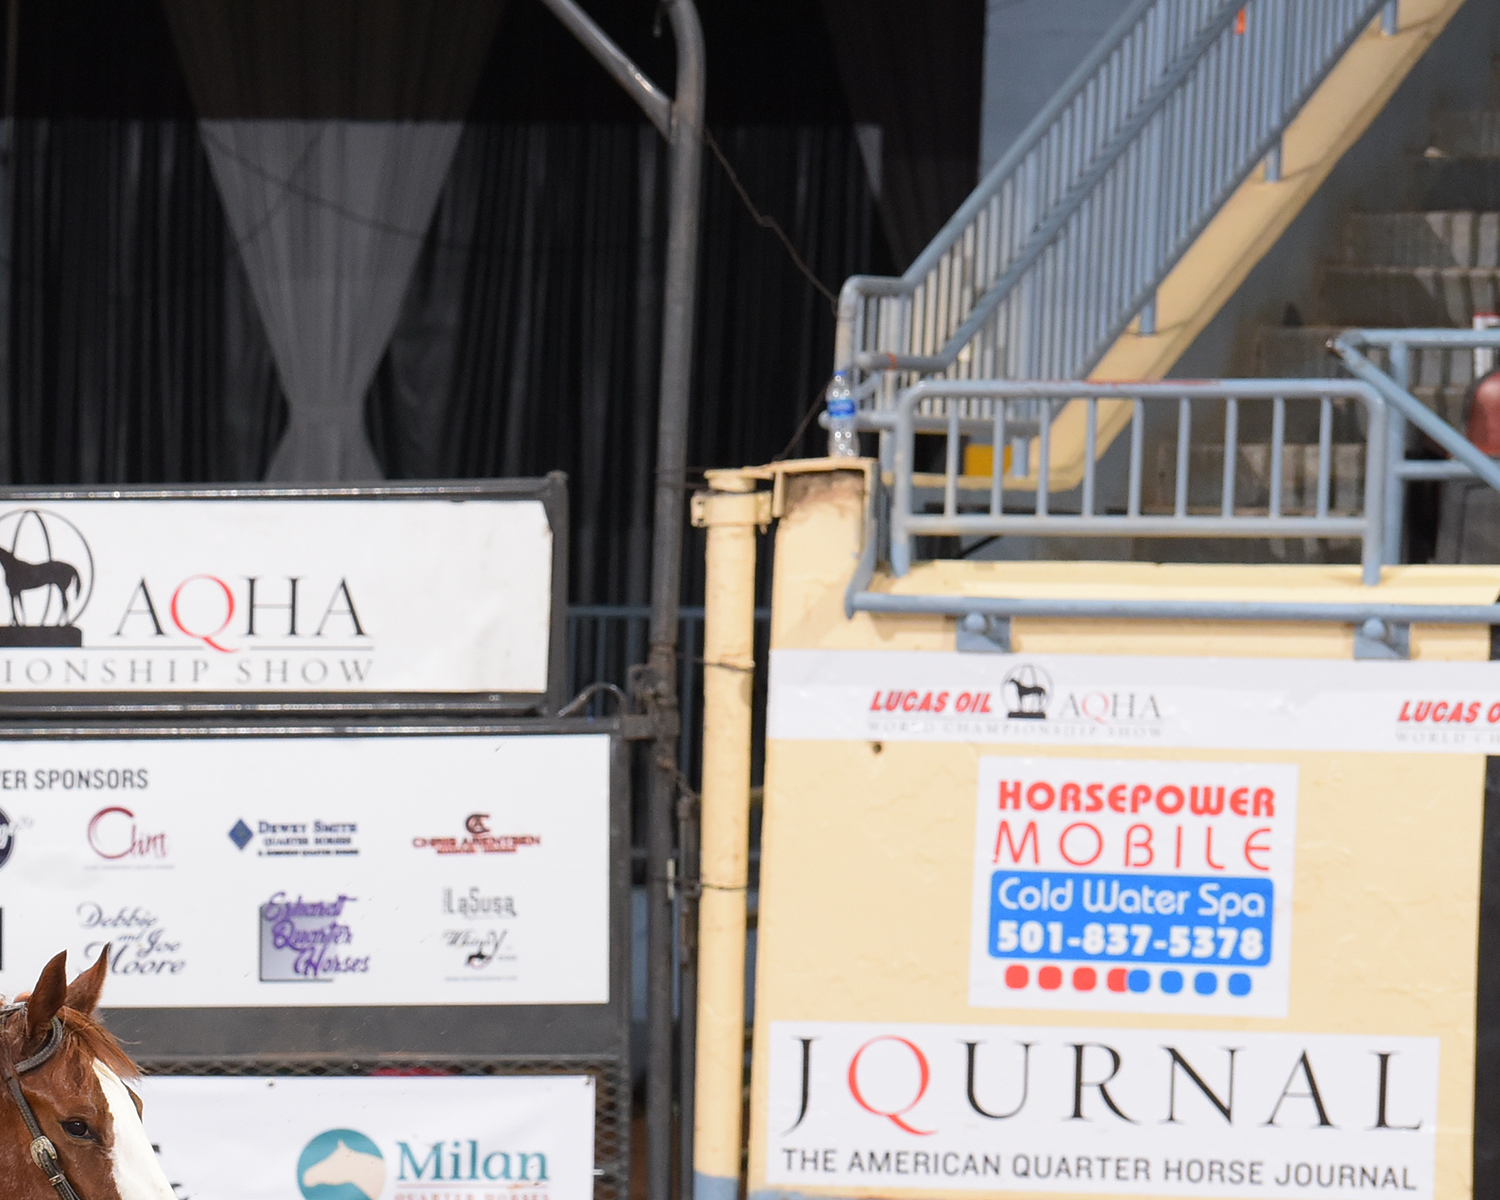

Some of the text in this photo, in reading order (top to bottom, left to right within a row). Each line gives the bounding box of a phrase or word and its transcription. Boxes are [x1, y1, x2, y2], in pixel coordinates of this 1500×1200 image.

[115, 574, 368, 654] AQHA
[237, 659, 373, 684] SHOW
[869, 690, 992, 714] LUCAS OIL
[1059, 690, 1161, 724] AQHA
[1397, 700, 1482, 725] LUCAS
[34, 768, 149, 791] SPONSORS
[998, 780, 1275, 817] HORSEPOWER
[993, 821, 1272, 871] MOBILE
[77, 902, 158, 930] Debbie
[997, 877, 1266, 922] Cold Water Spa
[996, 921, 1265, 960] 501-837-5378
[781, 1034, 1424, 1136] JQURNAL
[396, 1139, 550, 1181] Milan
[782, 1147, 1417, 1191] THE AMERICAN QUARTER HORSE JOURNAL
